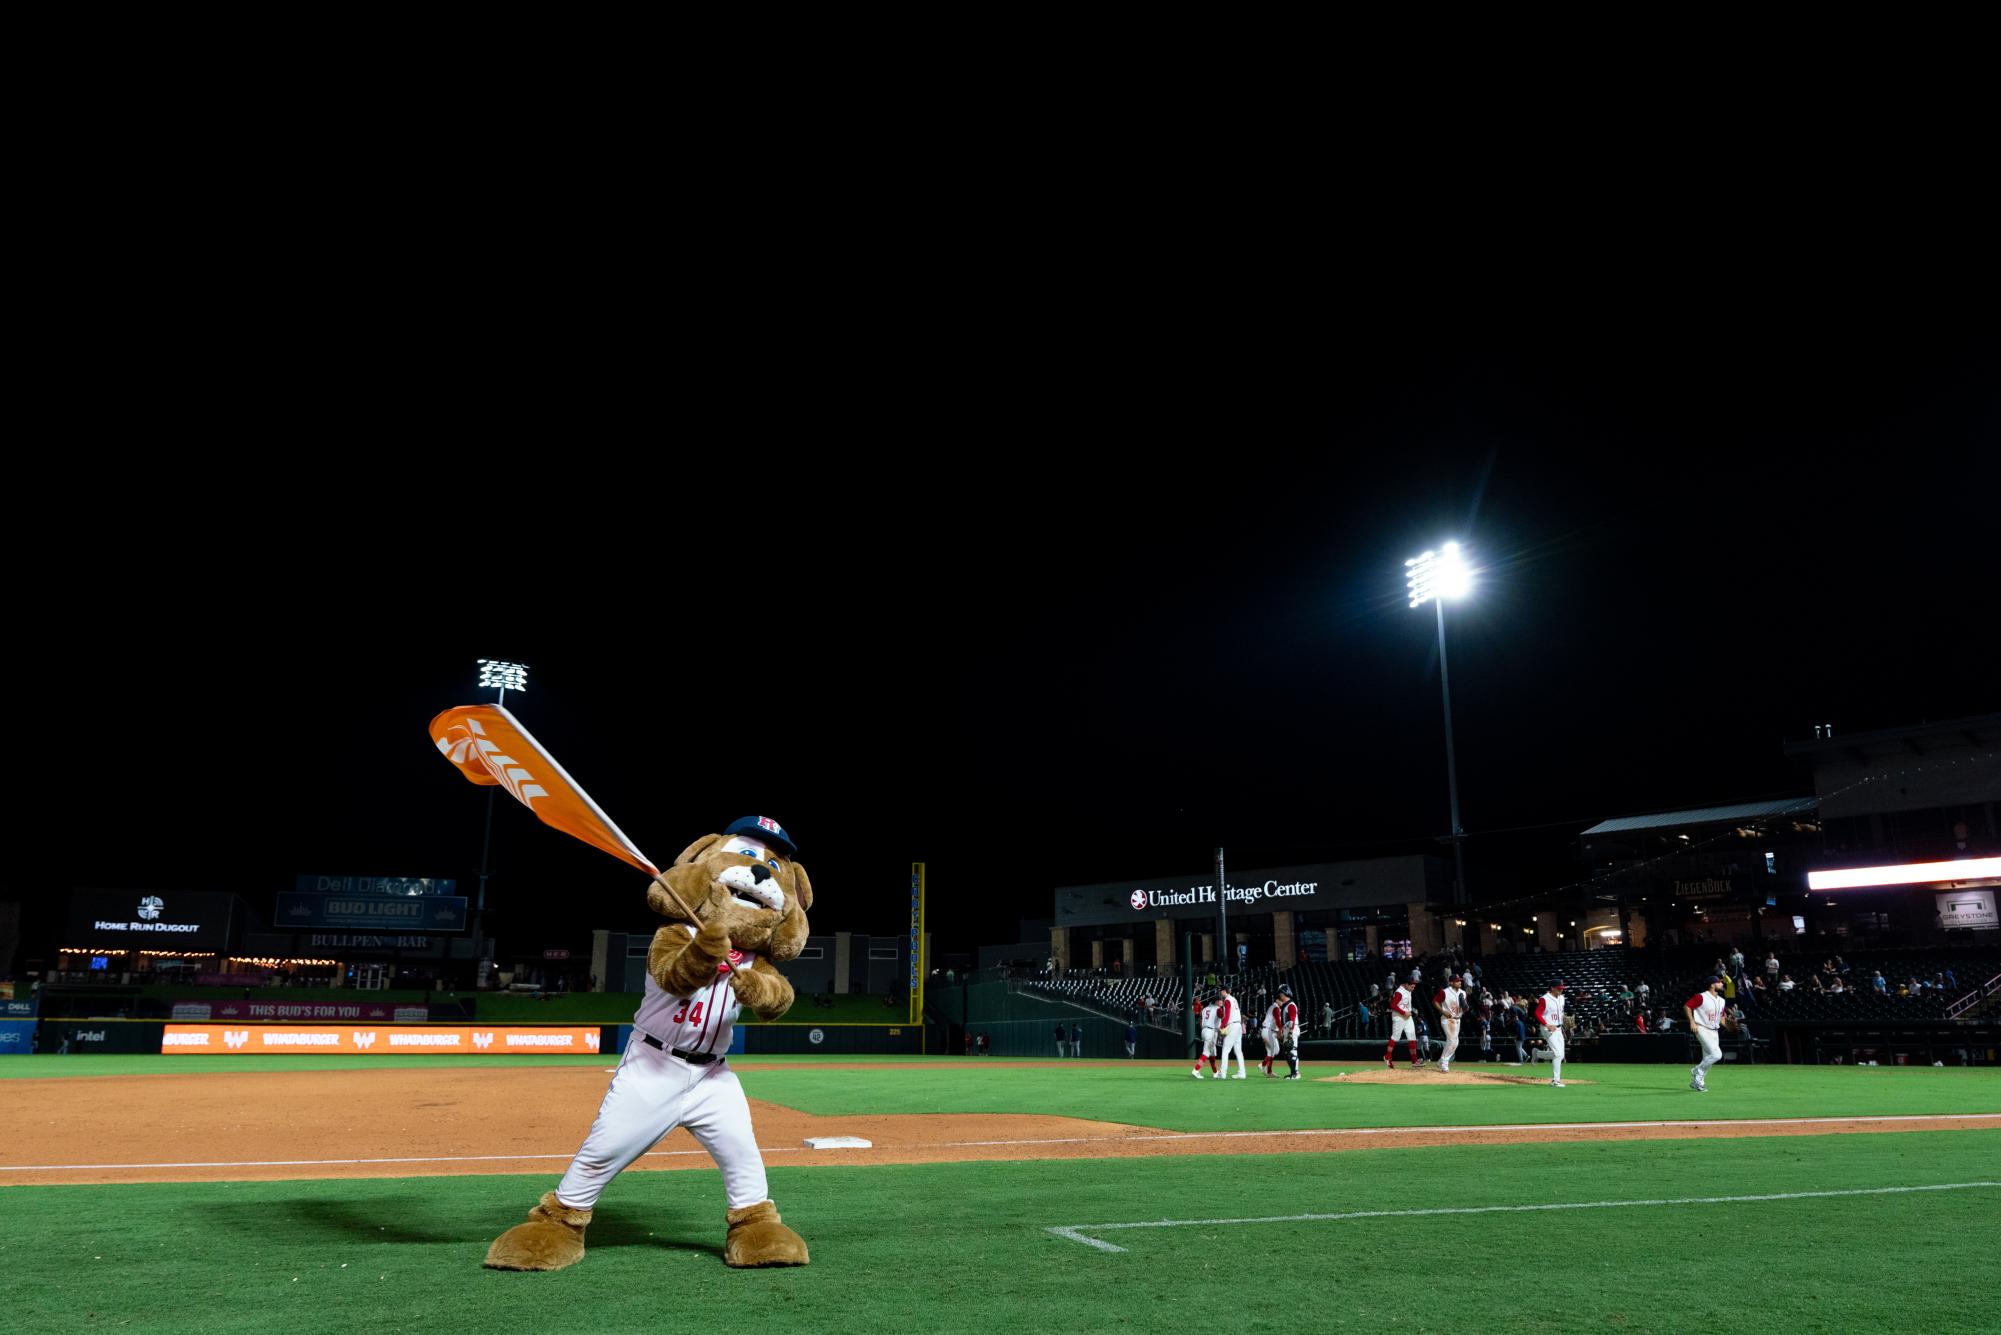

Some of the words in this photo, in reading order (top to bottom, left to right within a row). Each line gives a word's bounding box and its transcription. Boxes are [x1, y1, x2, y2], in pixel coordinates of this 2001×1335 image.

[316, 876, 350, 892] Dell
[1149, 888, 1195, 906] United
[1198, 884, 1262, 904] Heitage
[1264, 880, 1317, 898] Center
[328, 902, 367, 915] BUD
[369, 902, 421, 917] LIGHT
[95, 921, 128, 931] HOME
[129, 922, 155, 932] RUN
[155, 923, 200, 933] DUGOUT
[311, 934, 384, 947] BULLPEN
[397, 936, 427, 948] BAR
[249, 1004, 274, 1016] THIS
[277, 1005, 312, 1017] BUD'S
[314, 1006, 335, 1017] FOR
[338, 1006, 360, 1017] YOU
[673, 1000, 704, 1027] 34
[1205, 1010, 1210, 1019] 5
[76, 1030, 106, 1042] intel
[263, 1033, 339, 1045] WHATABURGER
[389, 1034, 461, 1046] WHATABURGER
[506, 1034, 573, 1046] WHATABURGER
